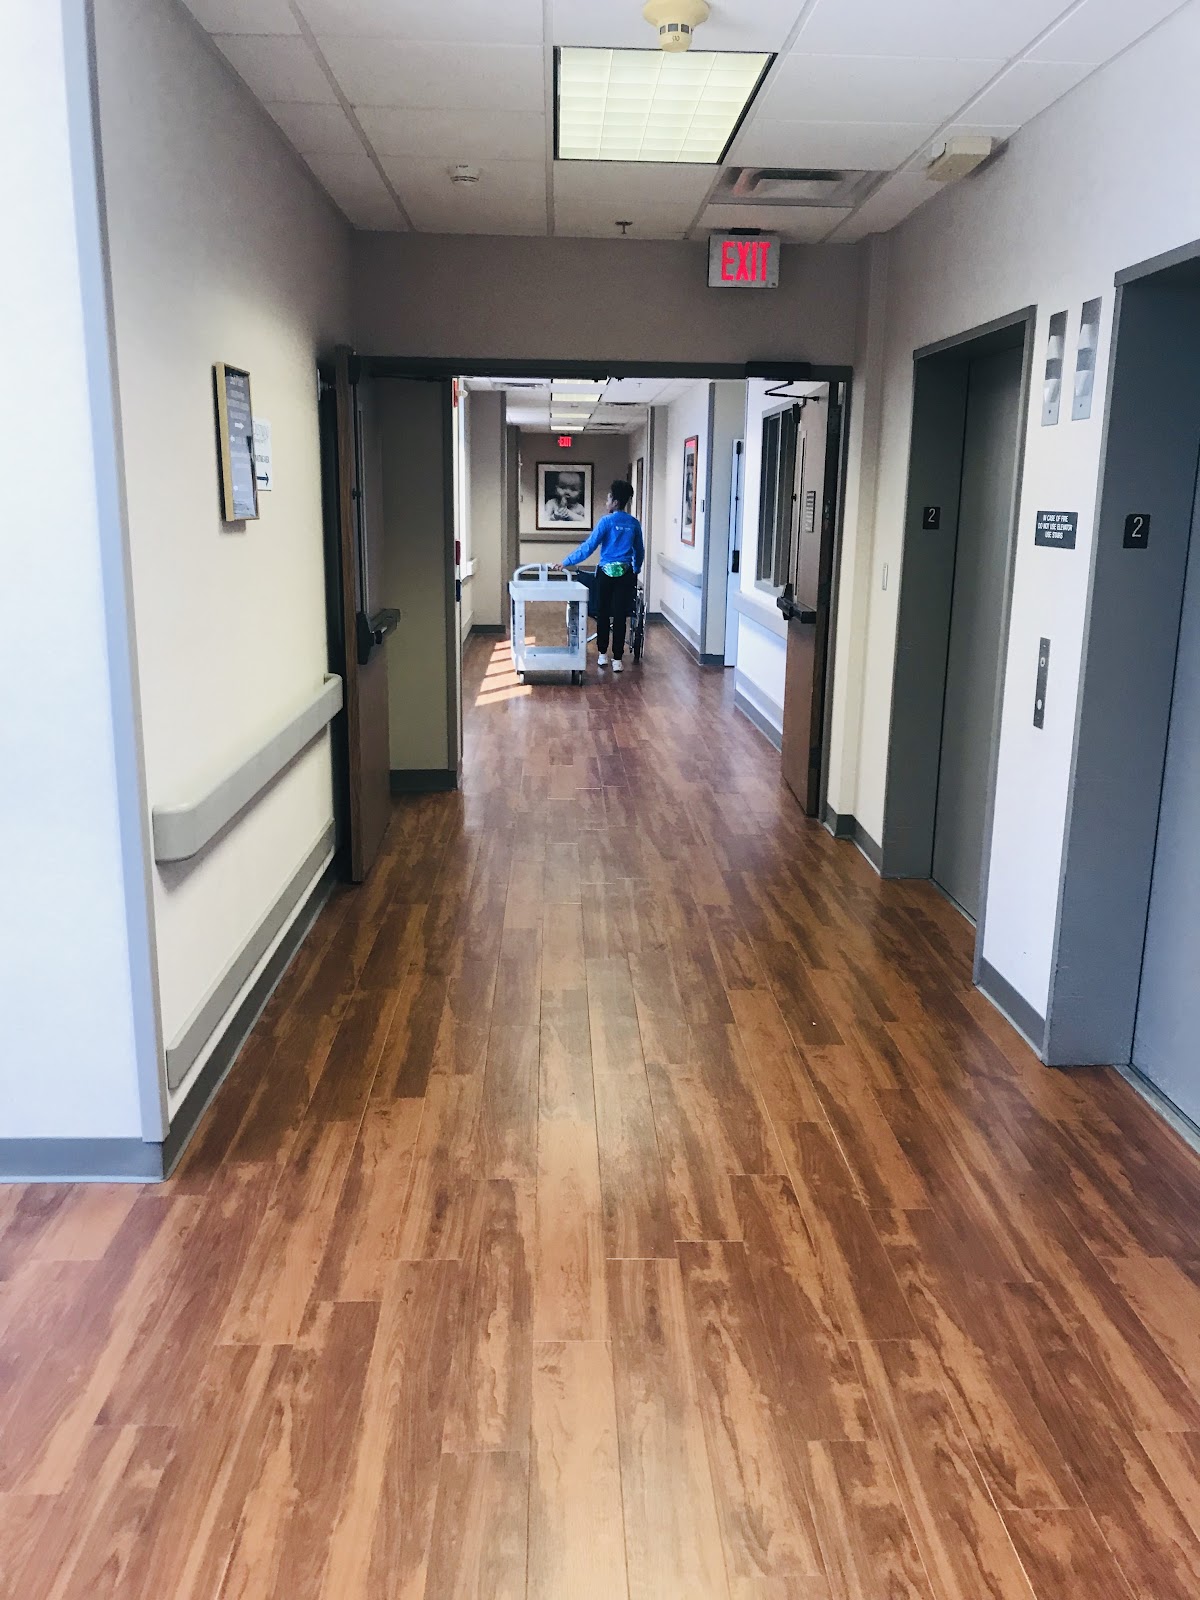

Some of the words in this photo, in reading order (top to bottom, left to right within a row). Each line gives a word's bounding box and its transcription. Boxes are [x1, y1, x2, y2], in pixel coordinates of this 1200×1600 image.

[721, 241, 771, 281] EXIT
[928, 508, 935, 522] 2
[1132, 516, 1143, 537] 2
[1052, 532, 1064, 540] STAIRS
